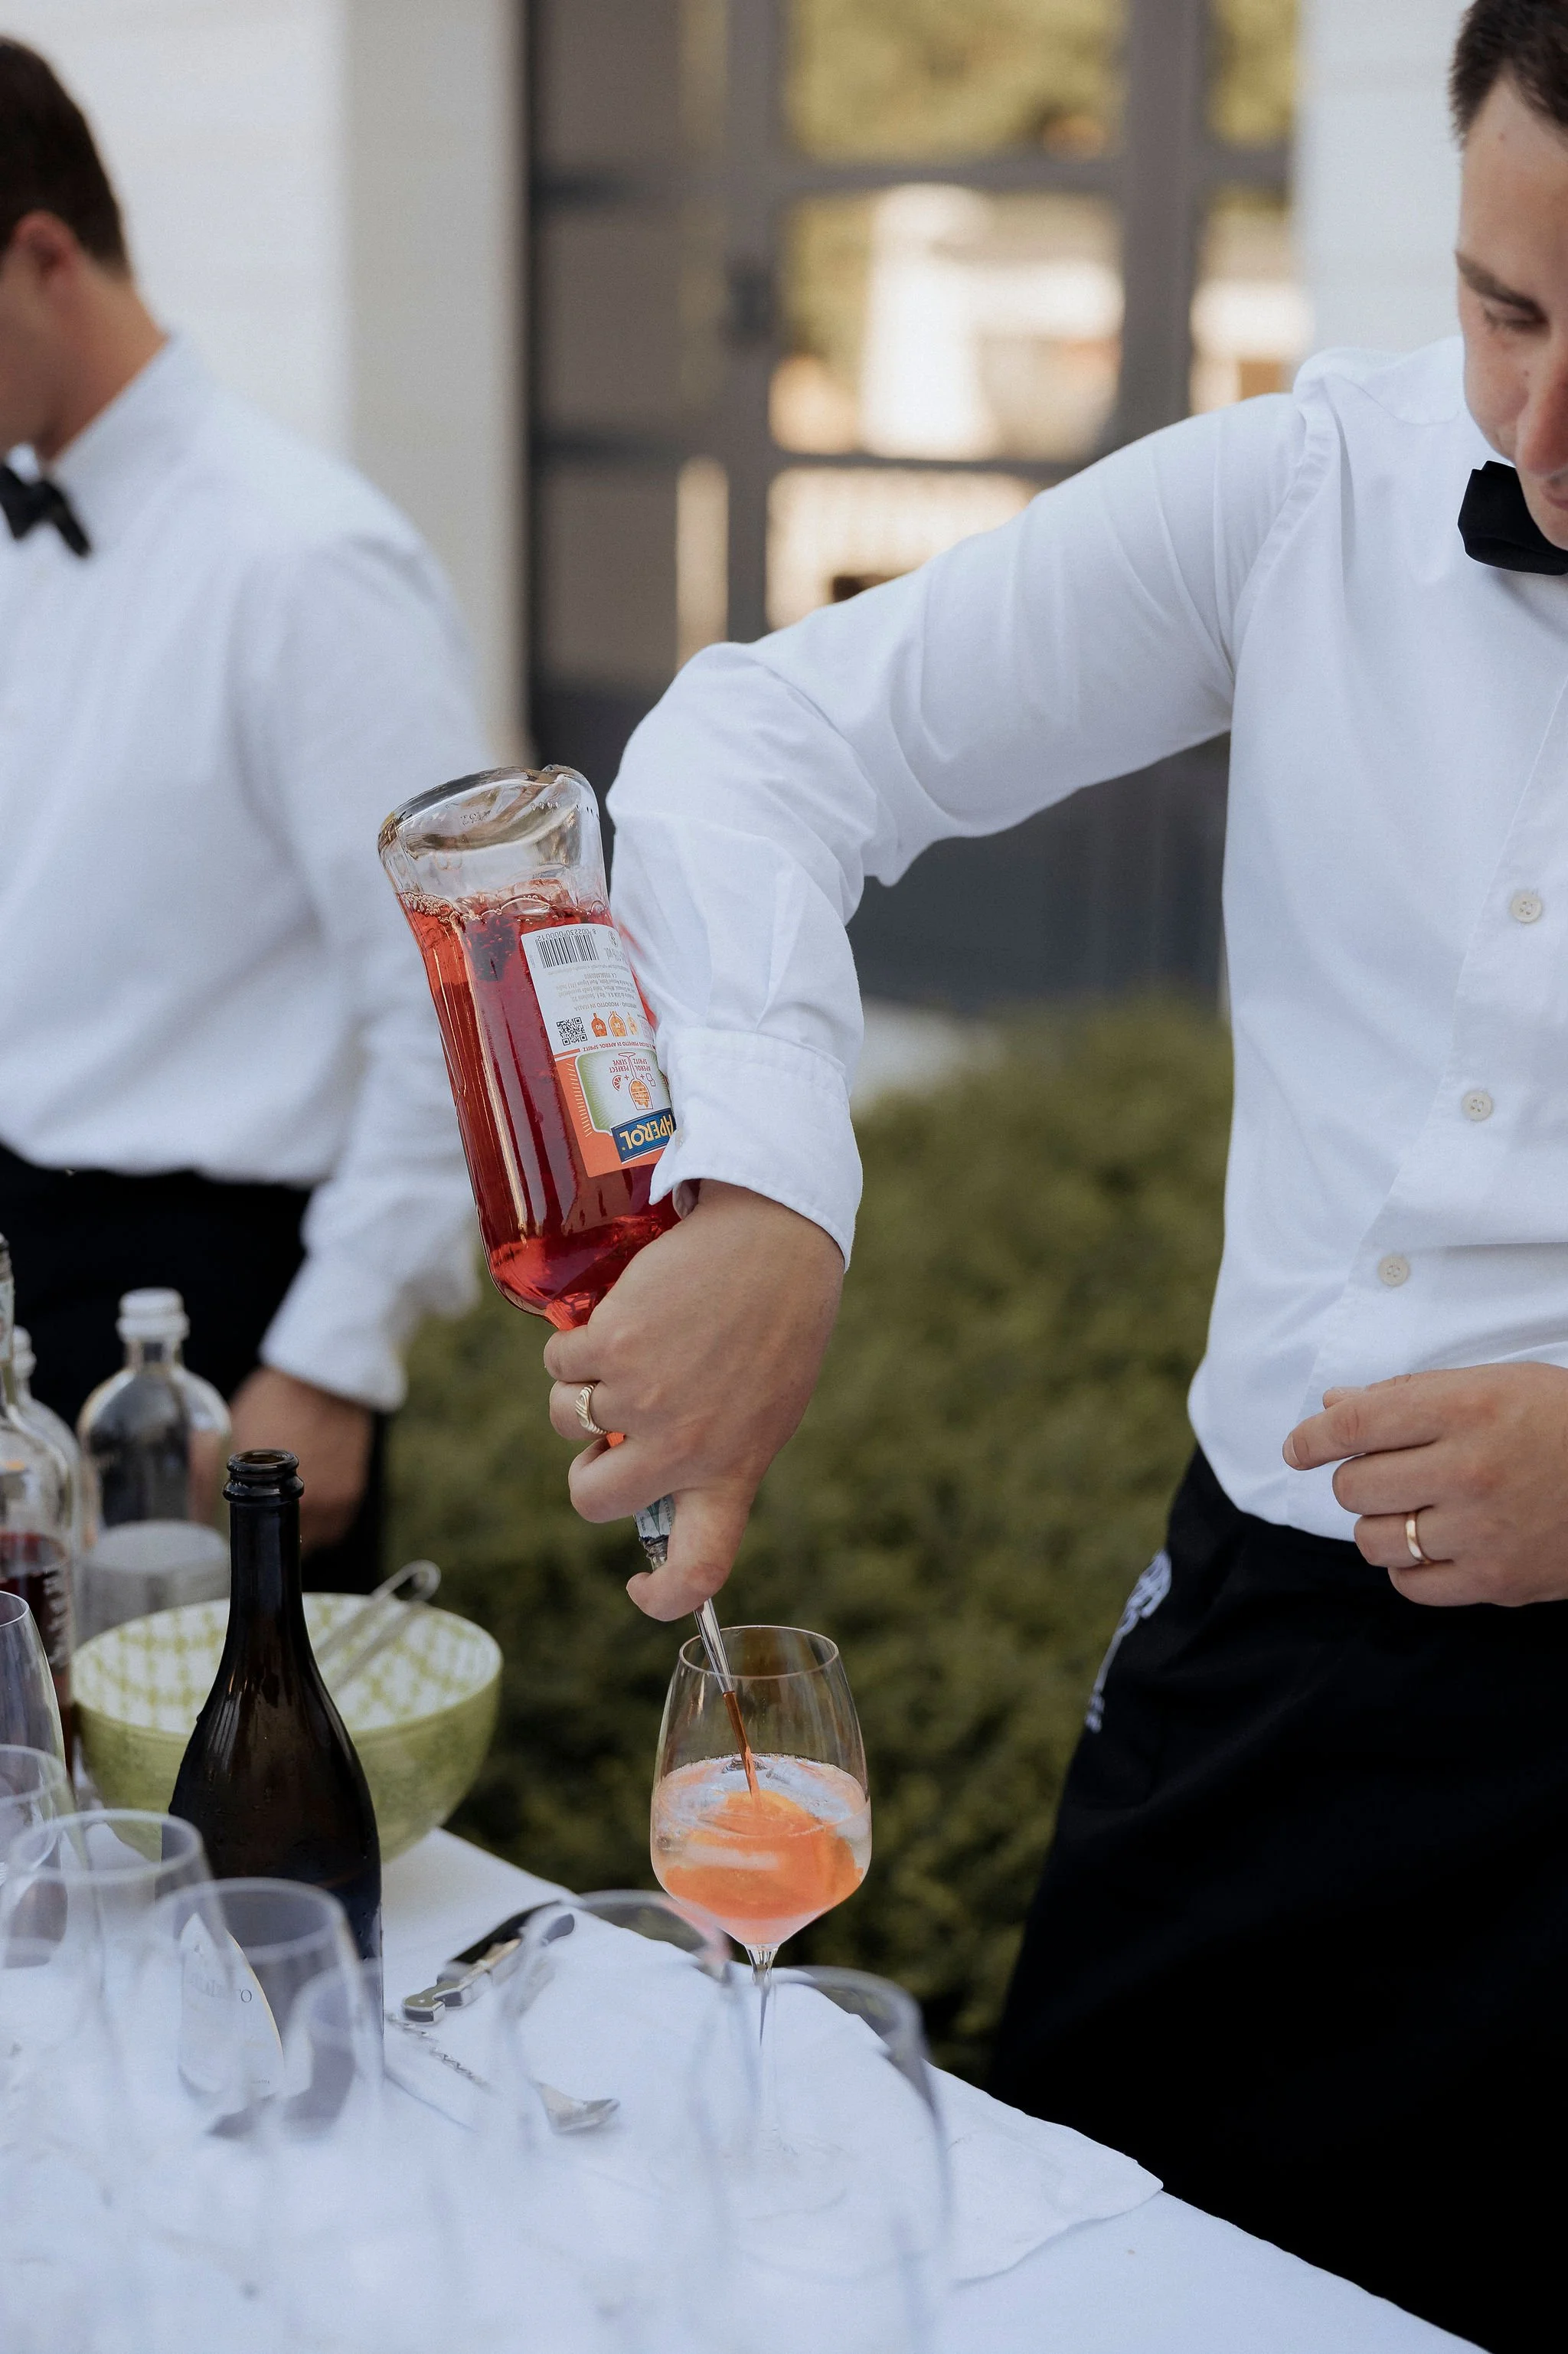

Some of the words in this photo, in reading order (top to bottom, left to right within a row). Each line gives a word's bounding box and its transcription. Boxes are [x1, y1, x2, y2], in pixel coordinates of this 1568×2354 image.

[537, 930, 564, 942] 000012
[583, 1044, 599, 1052] SPRITZ
[612, 1058, 628, 1067] SERVE
[609, 1064, 629, 1074] PERFECT
[619, 1113, 674, 1149] APEROL
